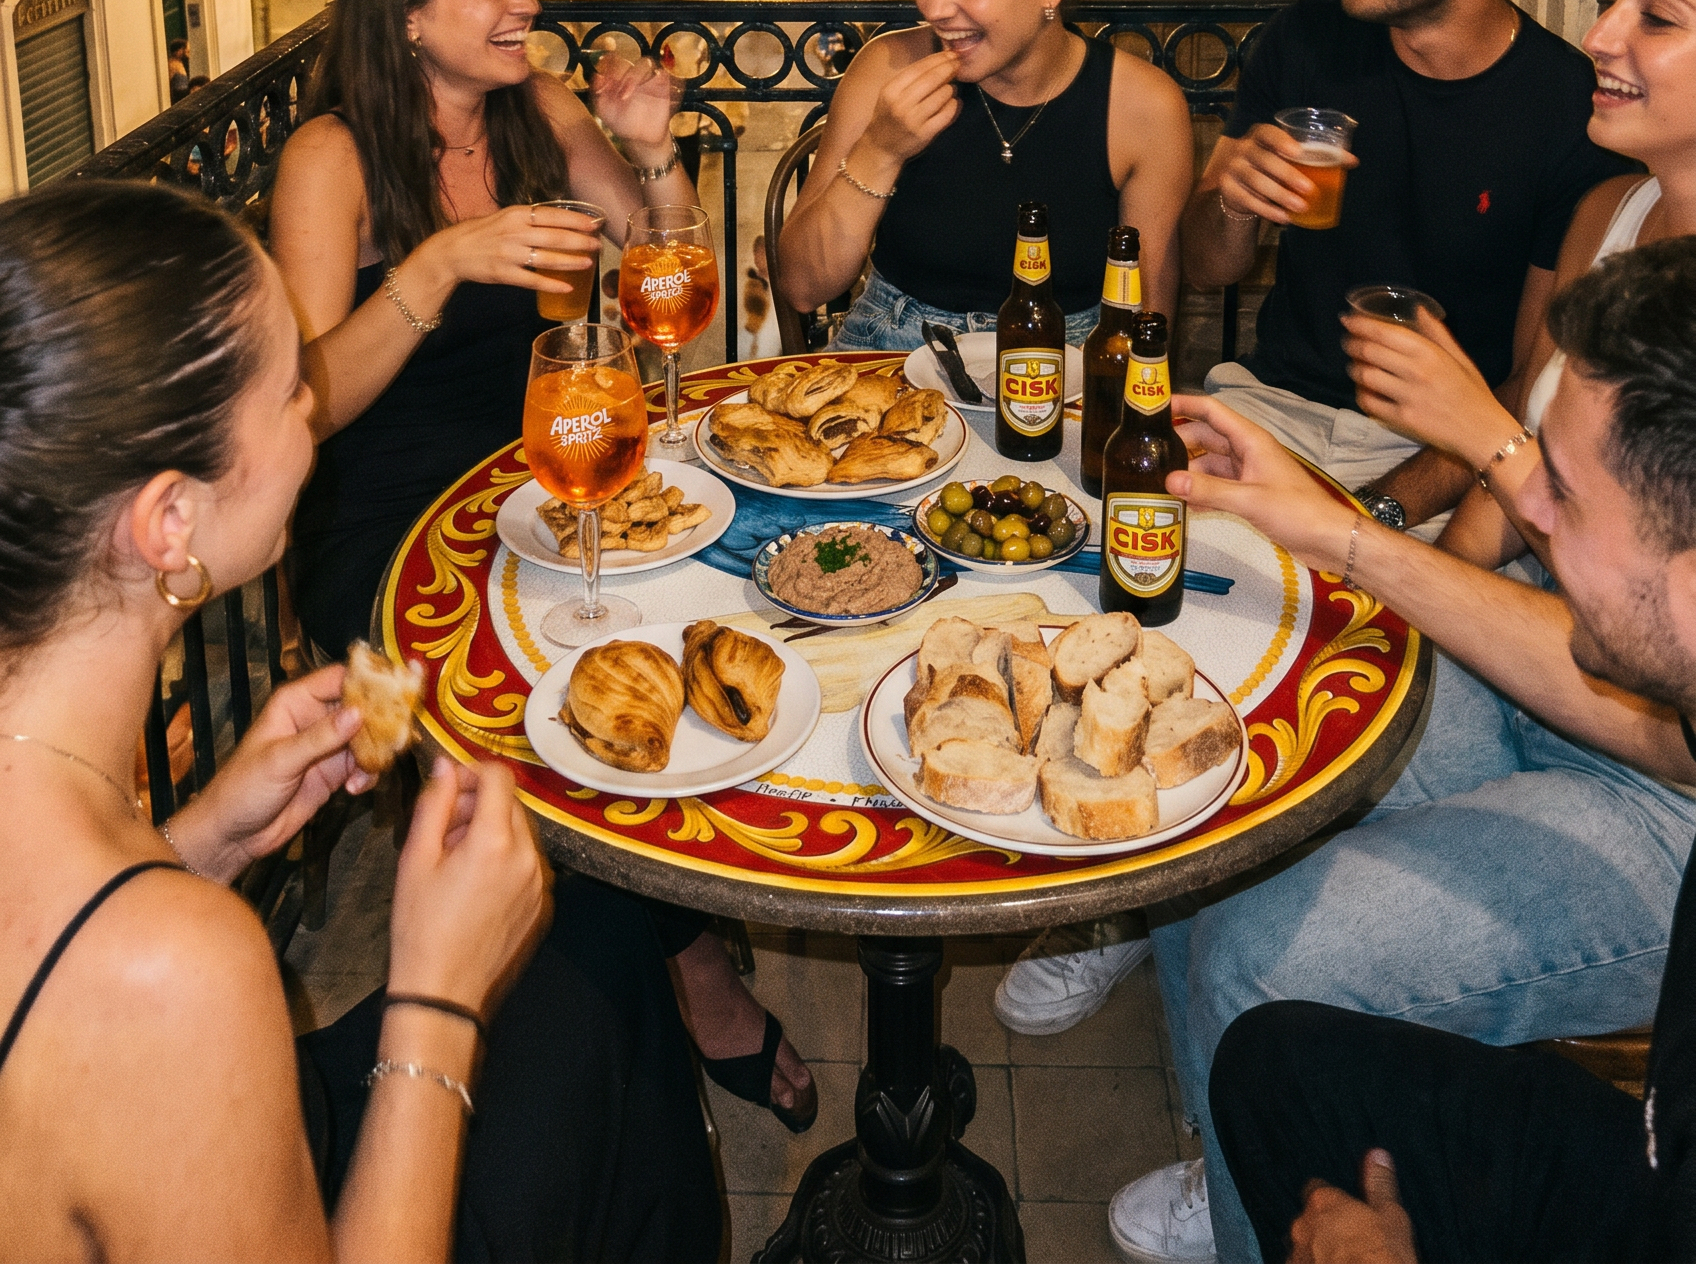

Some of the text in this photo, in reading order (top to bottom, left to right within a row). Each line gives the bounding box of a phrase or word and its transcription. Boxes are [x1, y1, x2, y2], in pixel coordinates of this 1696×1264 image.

[640, 269, 691, 293] APEROL
[1005, 377, 1059, 397] CISK
[1132, 383, 1165, 396] CISK
[550, 407, 612, 436] APEROL
[1113, 526, 1176, 552] CISK
